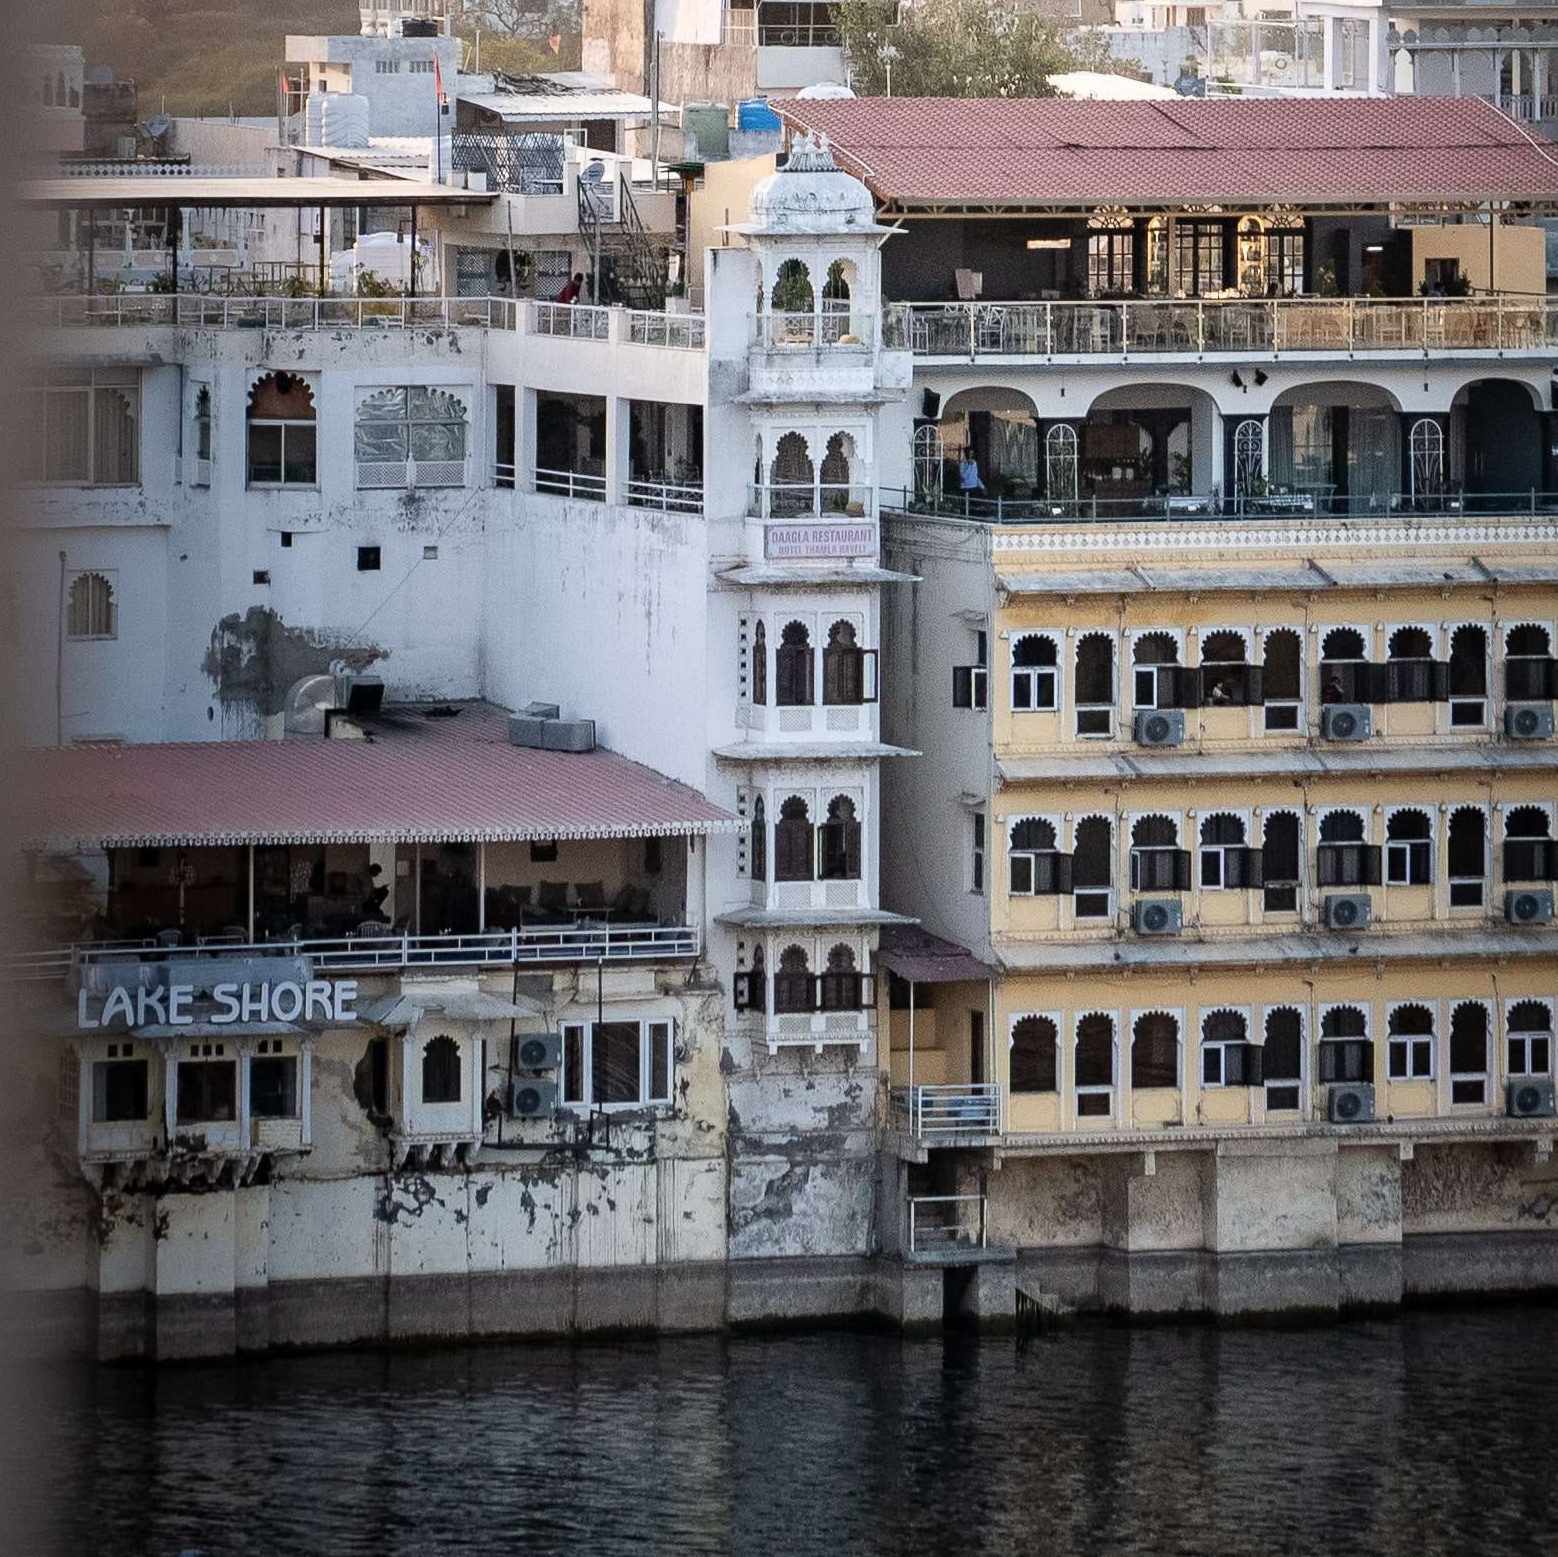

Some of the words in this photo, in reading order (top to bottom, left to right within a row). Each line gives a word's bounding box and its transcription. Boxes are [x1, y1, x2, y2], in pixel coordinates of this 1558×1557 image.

[812, 529, 873, 543] RESTAURANT
[78, 984, 194, 1028] LAKE
[210, 980, 359, 1024] SHORE
